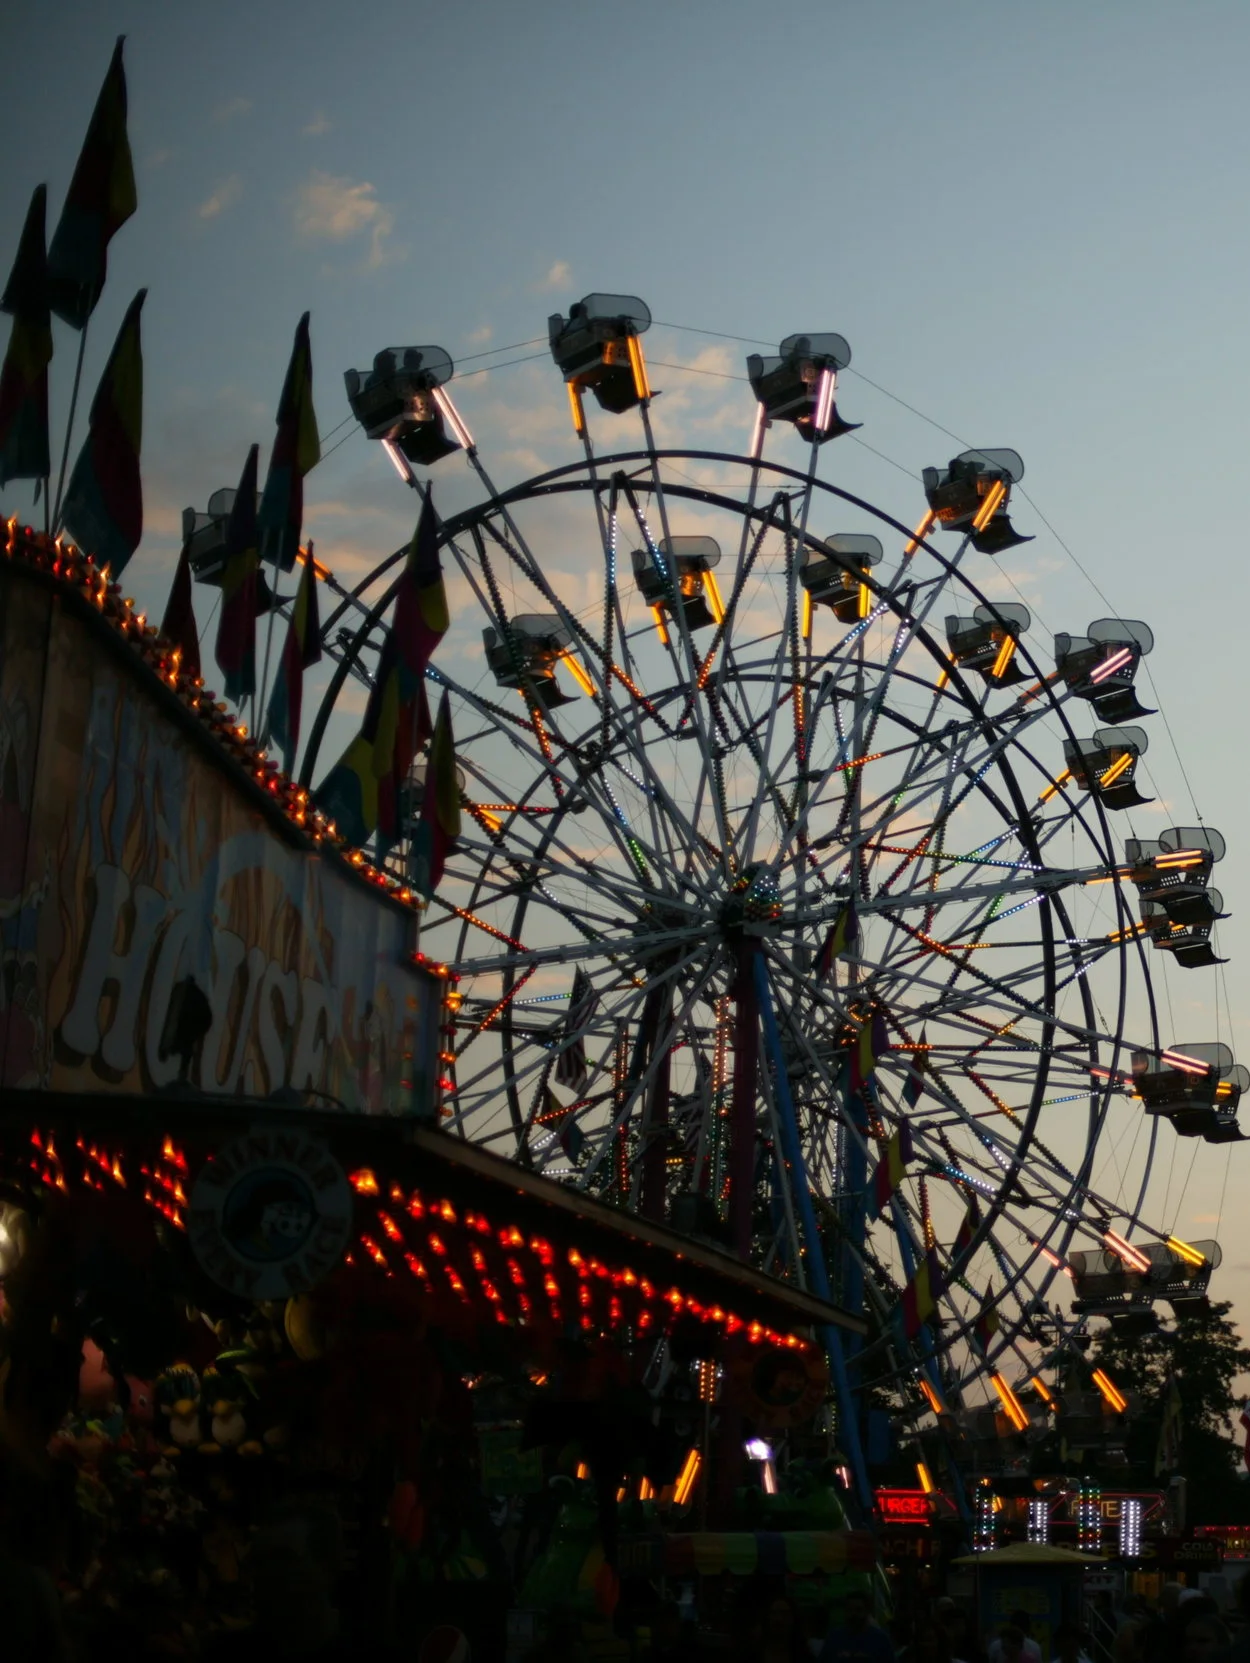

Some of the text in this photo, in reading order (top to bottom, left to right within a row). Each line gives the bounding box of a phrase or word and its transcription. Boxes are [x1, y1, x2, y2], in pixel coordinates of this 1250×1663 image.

[204, 1134, 338, 1190] WINNER
[191, 1209, 346, 1293] EVERY RACE
[878, 1496, 929, 1514] URGE
[1083, 1574, 1114, 1584] XIT
